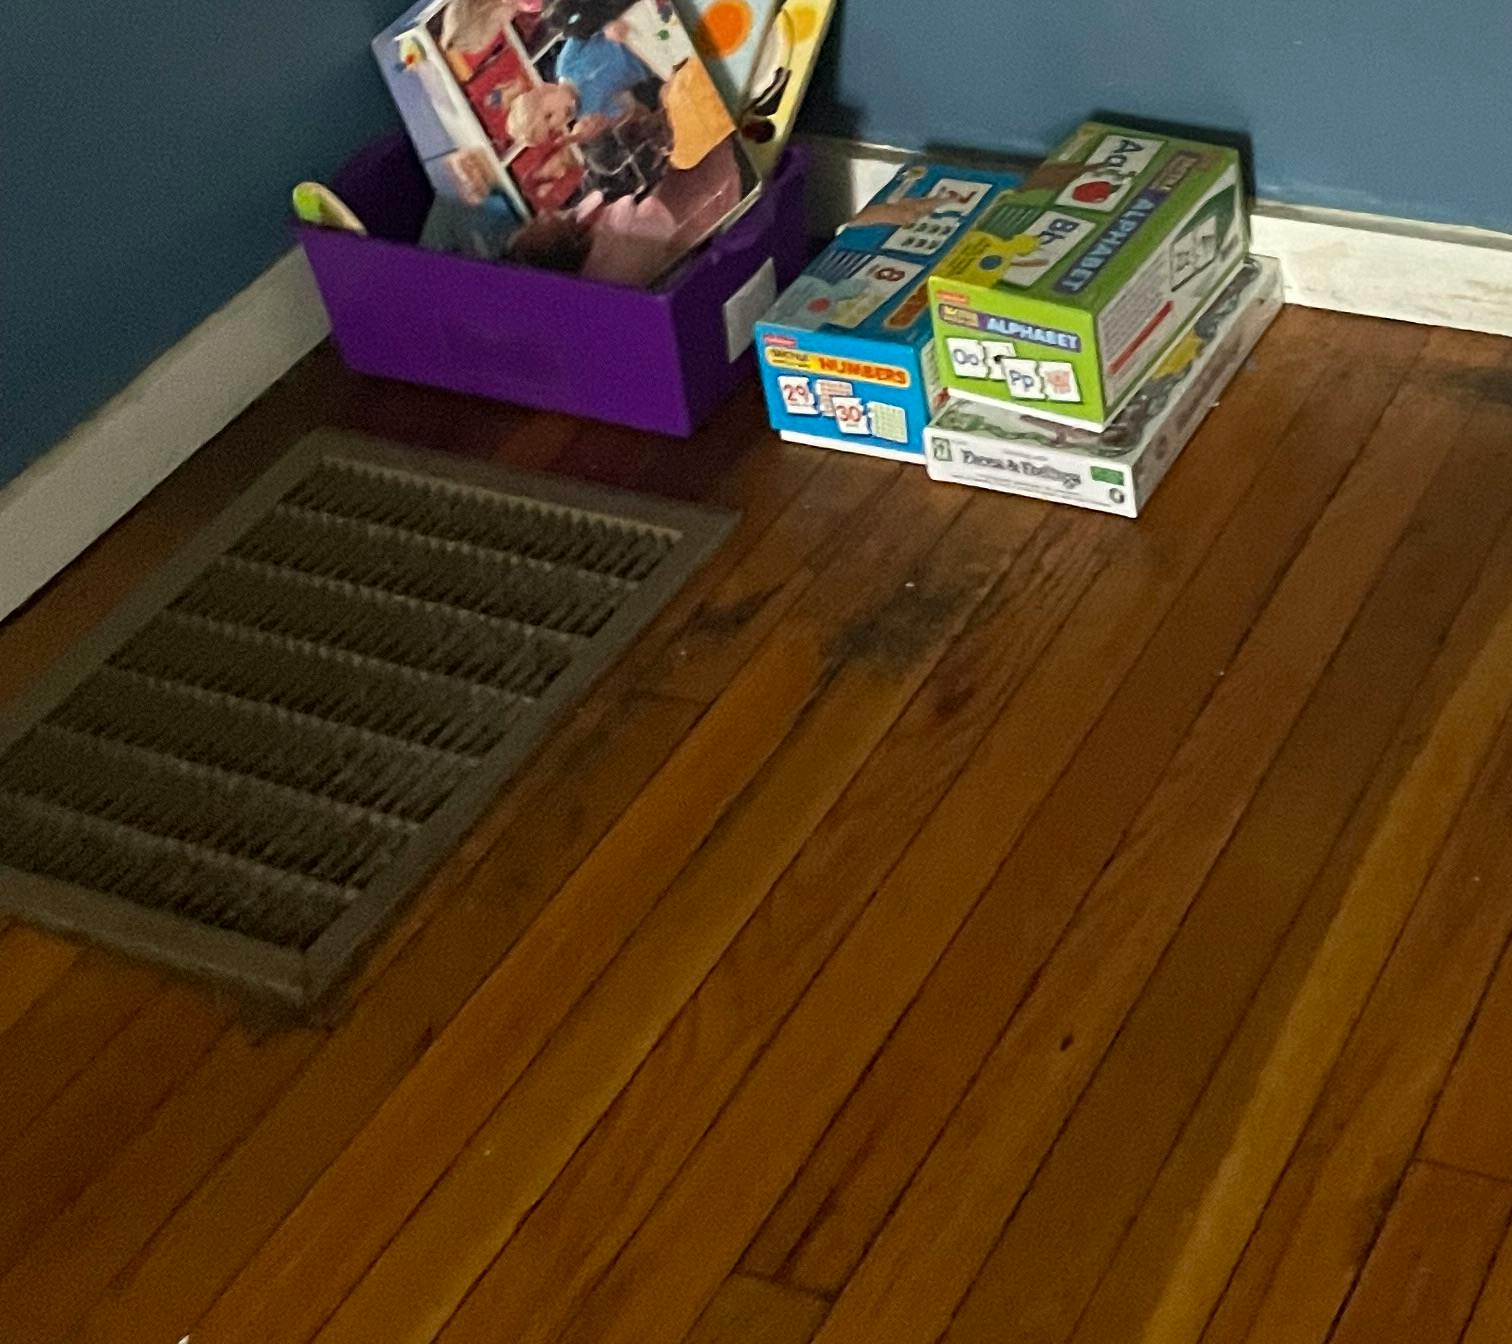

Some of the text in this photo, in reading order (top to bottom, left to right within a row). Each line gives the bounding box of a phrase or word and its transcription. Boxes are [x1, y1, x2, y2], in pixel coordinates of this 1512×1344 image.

[1061, 198, 1156, 292] ALPHABET
[986, 317, 1078, 350] ALPHABET
[818, 356, 906, 385] NUMBERS
[836, 405, 861, 422] 30
